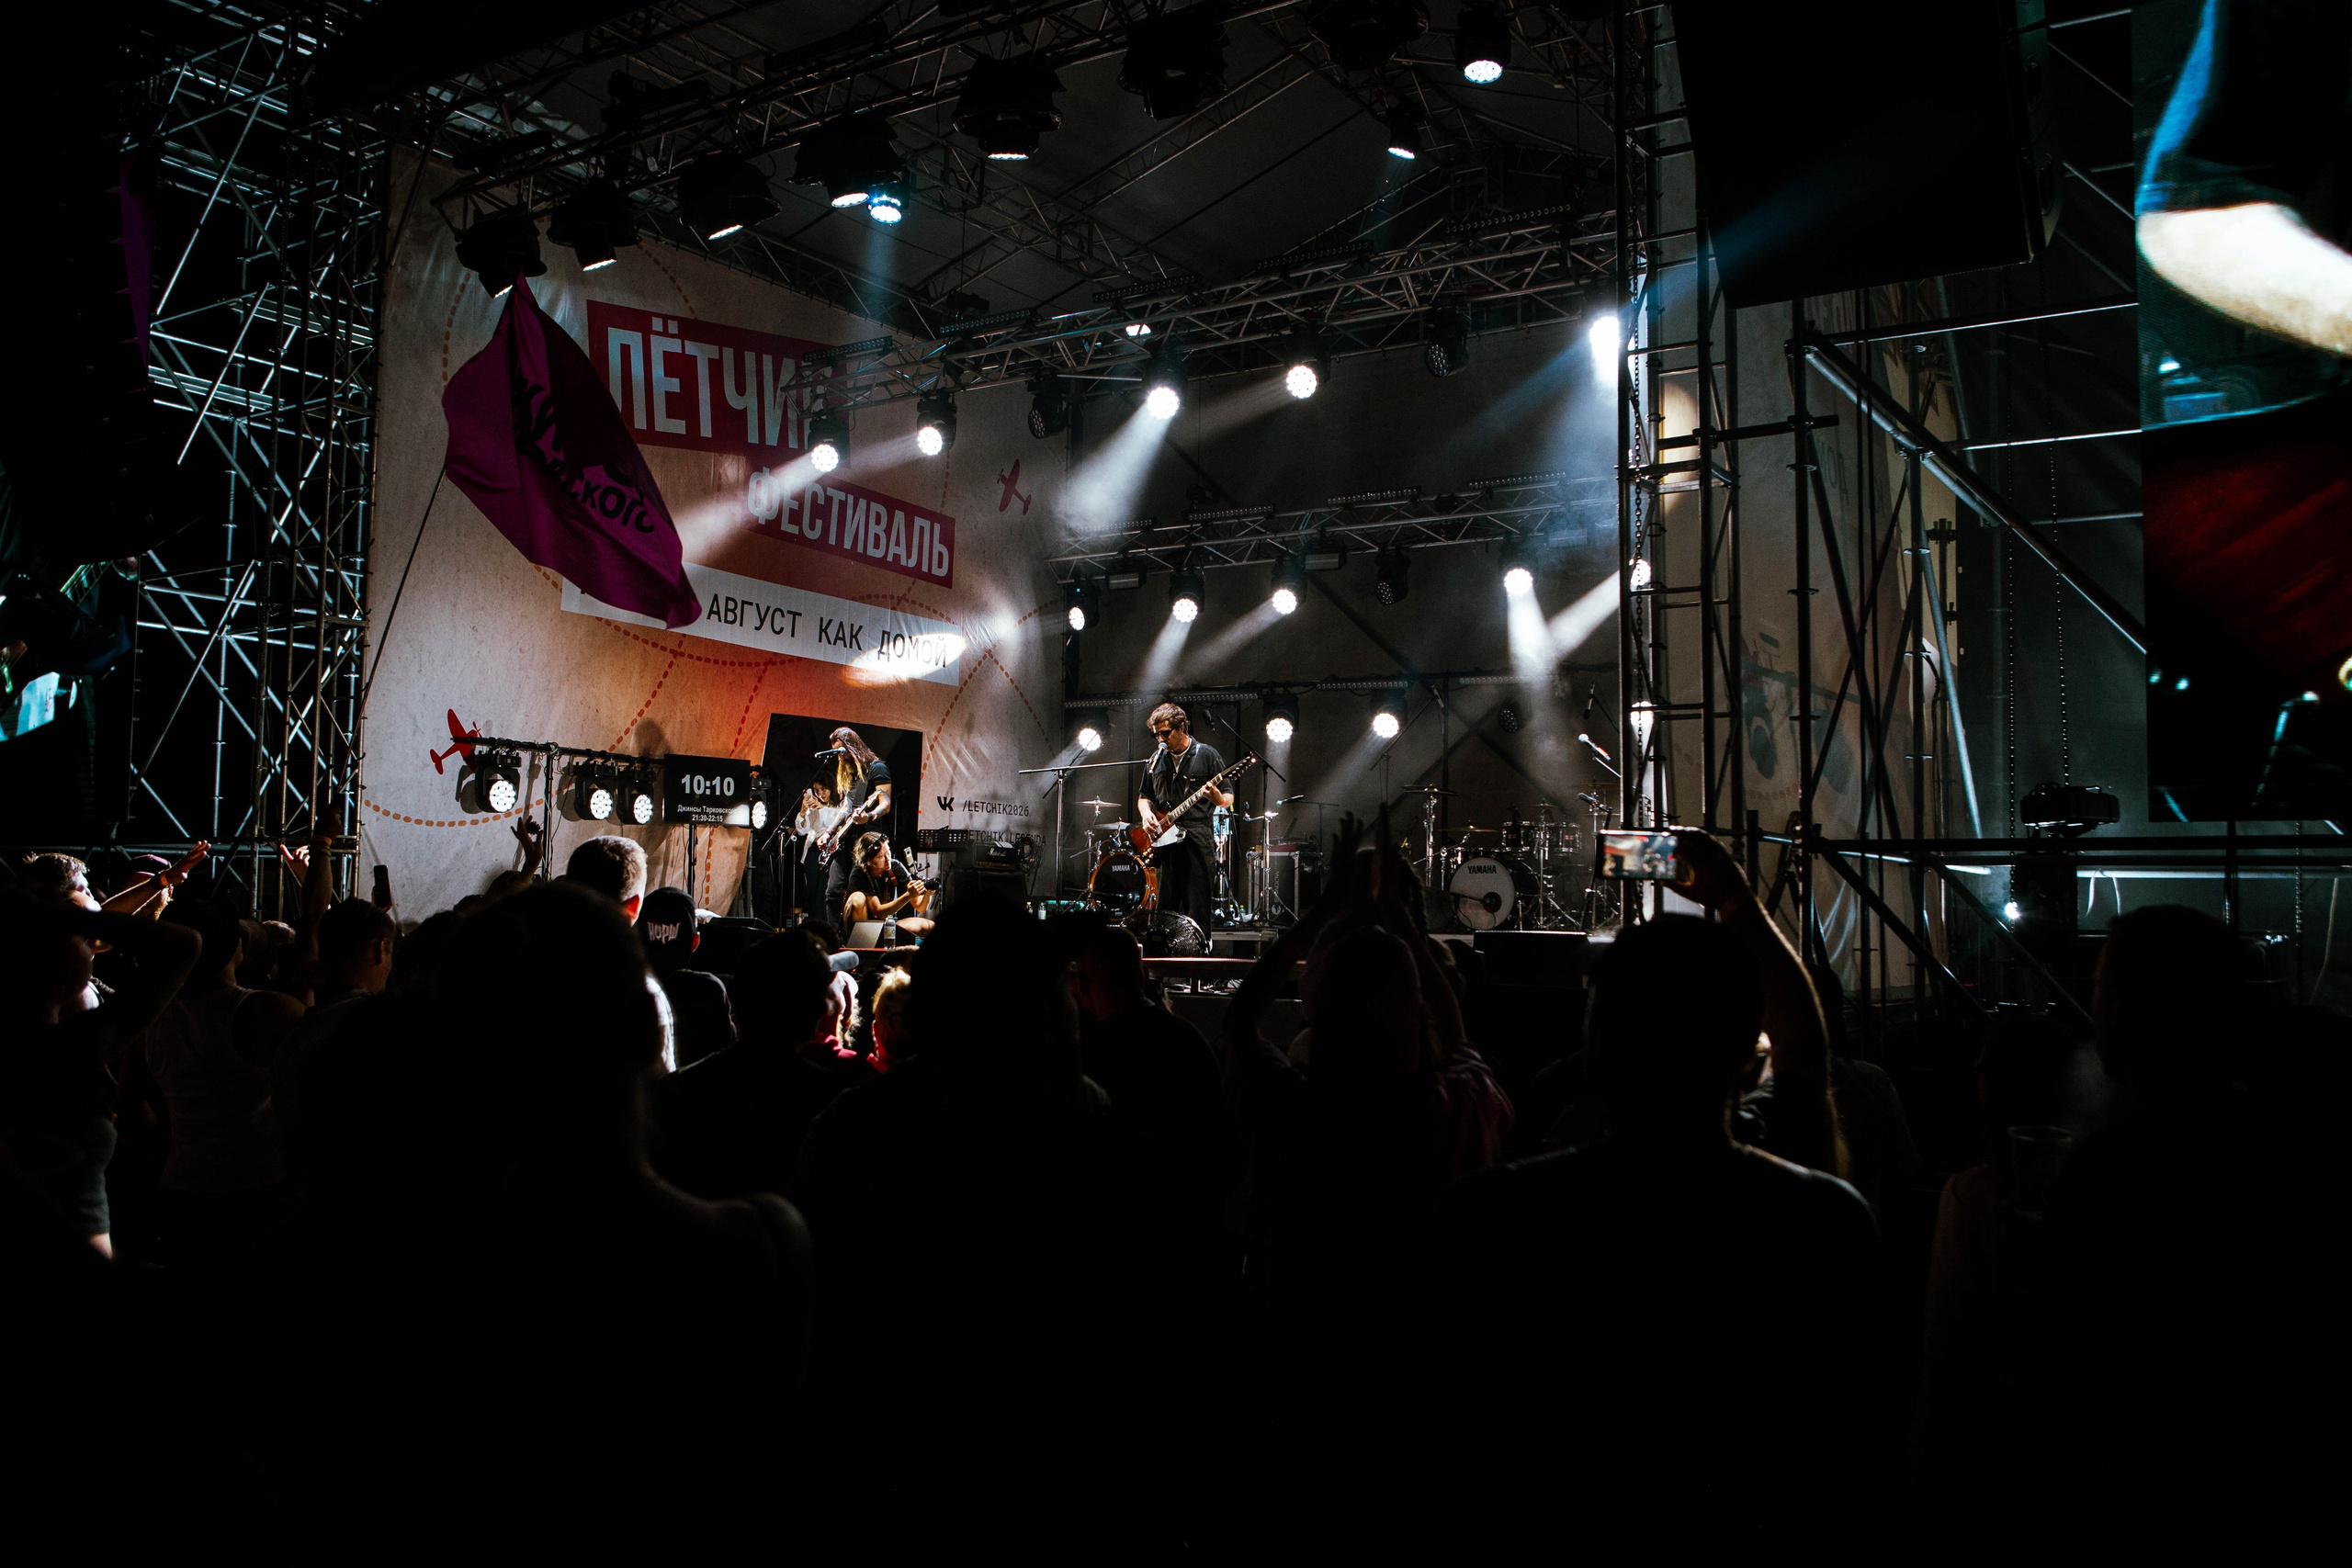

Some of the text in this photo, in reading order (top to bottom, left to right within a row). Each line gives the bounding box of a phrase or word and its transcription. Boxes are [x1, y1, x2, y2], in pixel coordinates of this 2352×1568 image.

[747, 466, 950, 578] ФЕСТИВАЛЬ
[706, 592, 947, 669] АВГУСТ КАК ДОМОЙ
[681, 773, 735, 796] 10:10
[677, 804, 702, 813] Джинсы
[962, 800, 1030, 817] /LETCHIK2026
[692, 814, 723, 822] 21:30-22:15
[1467, 864, 1497, 874] YAMAHA
